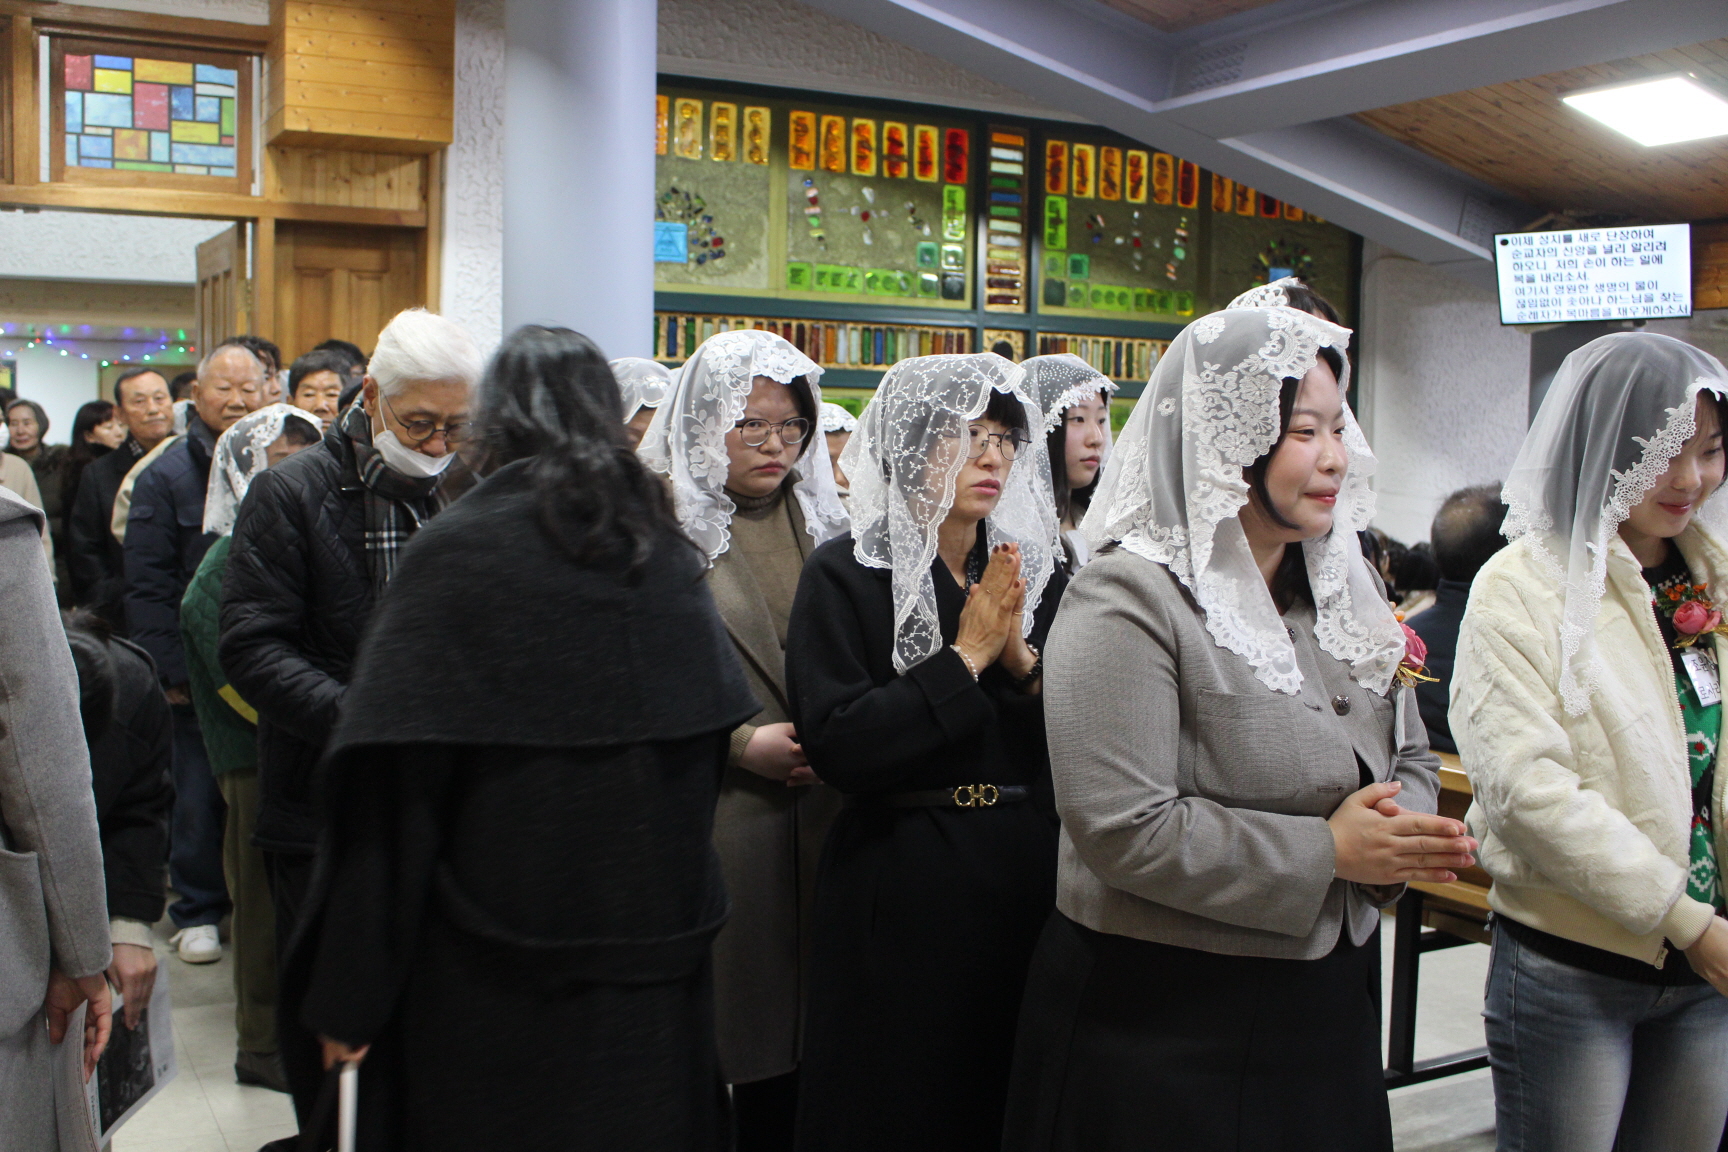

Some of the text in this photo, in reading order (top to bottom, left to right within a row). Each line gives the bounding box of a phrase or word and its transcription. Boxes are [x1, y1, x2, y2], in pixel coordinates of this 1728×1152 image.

[1511, 229, 1654, 246] 이제 성지를 새로 단장하여
[1512, 241, 1666, 260] 순교자의 신앙을 널리 알리려
[1513, 254, 1663, 271] 하오니 저희 손이 하는 일에
[1514, 274, 1535, 283] 복을
[1515, 280, 1658, 296] 여기서 영원한 생명의 물이
[1567, 295, 1601, 307] 솟아나
[1607, 293, 1654, 304] 하느님을
[1660, 292, 1683, 302] 찾는
[1567, 307, 1611, 319] 목마름을
